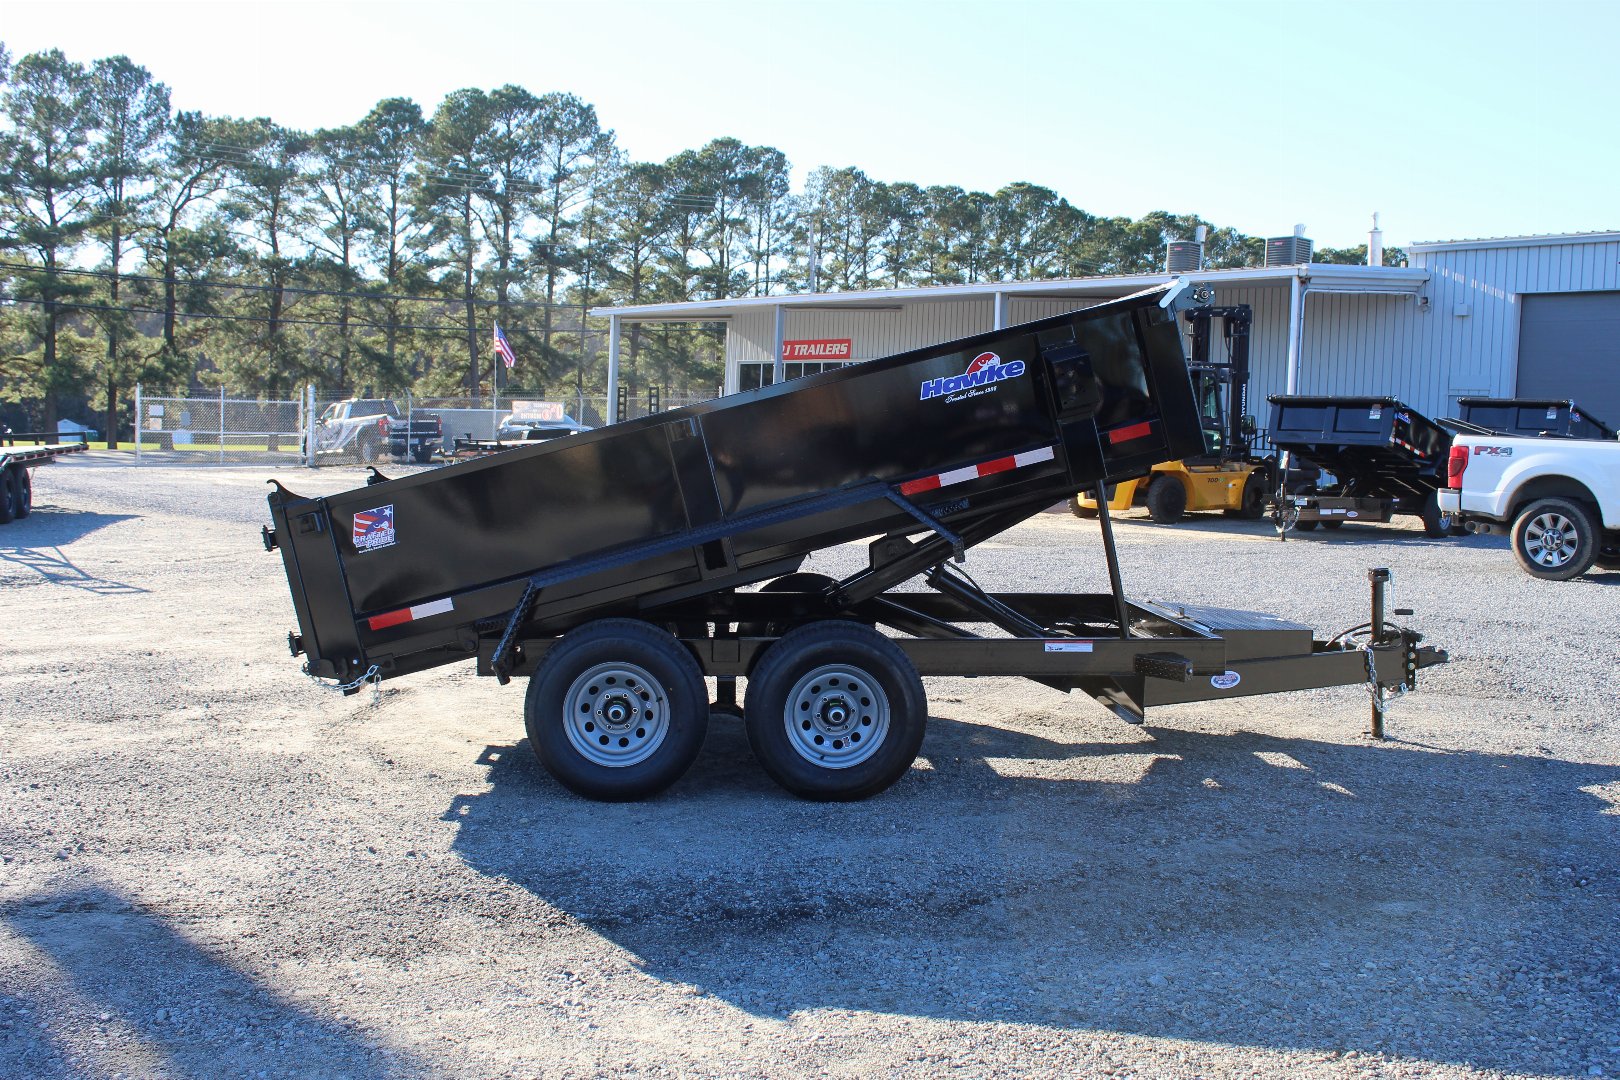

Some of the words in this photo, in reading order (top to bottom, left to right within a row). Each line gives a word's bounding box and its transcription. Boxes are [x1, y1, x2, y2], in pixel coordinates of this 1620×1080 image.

[782, 344, 791, 356] J
[794, 343, 848, 356] TRAILERS
[920, 360, 1025, 400] Hawke
[1474, 446, 1512, 455] FX4
[353, 528, 395, 544] CRAFTED
[367, 535, 395, 548] PRIDE
